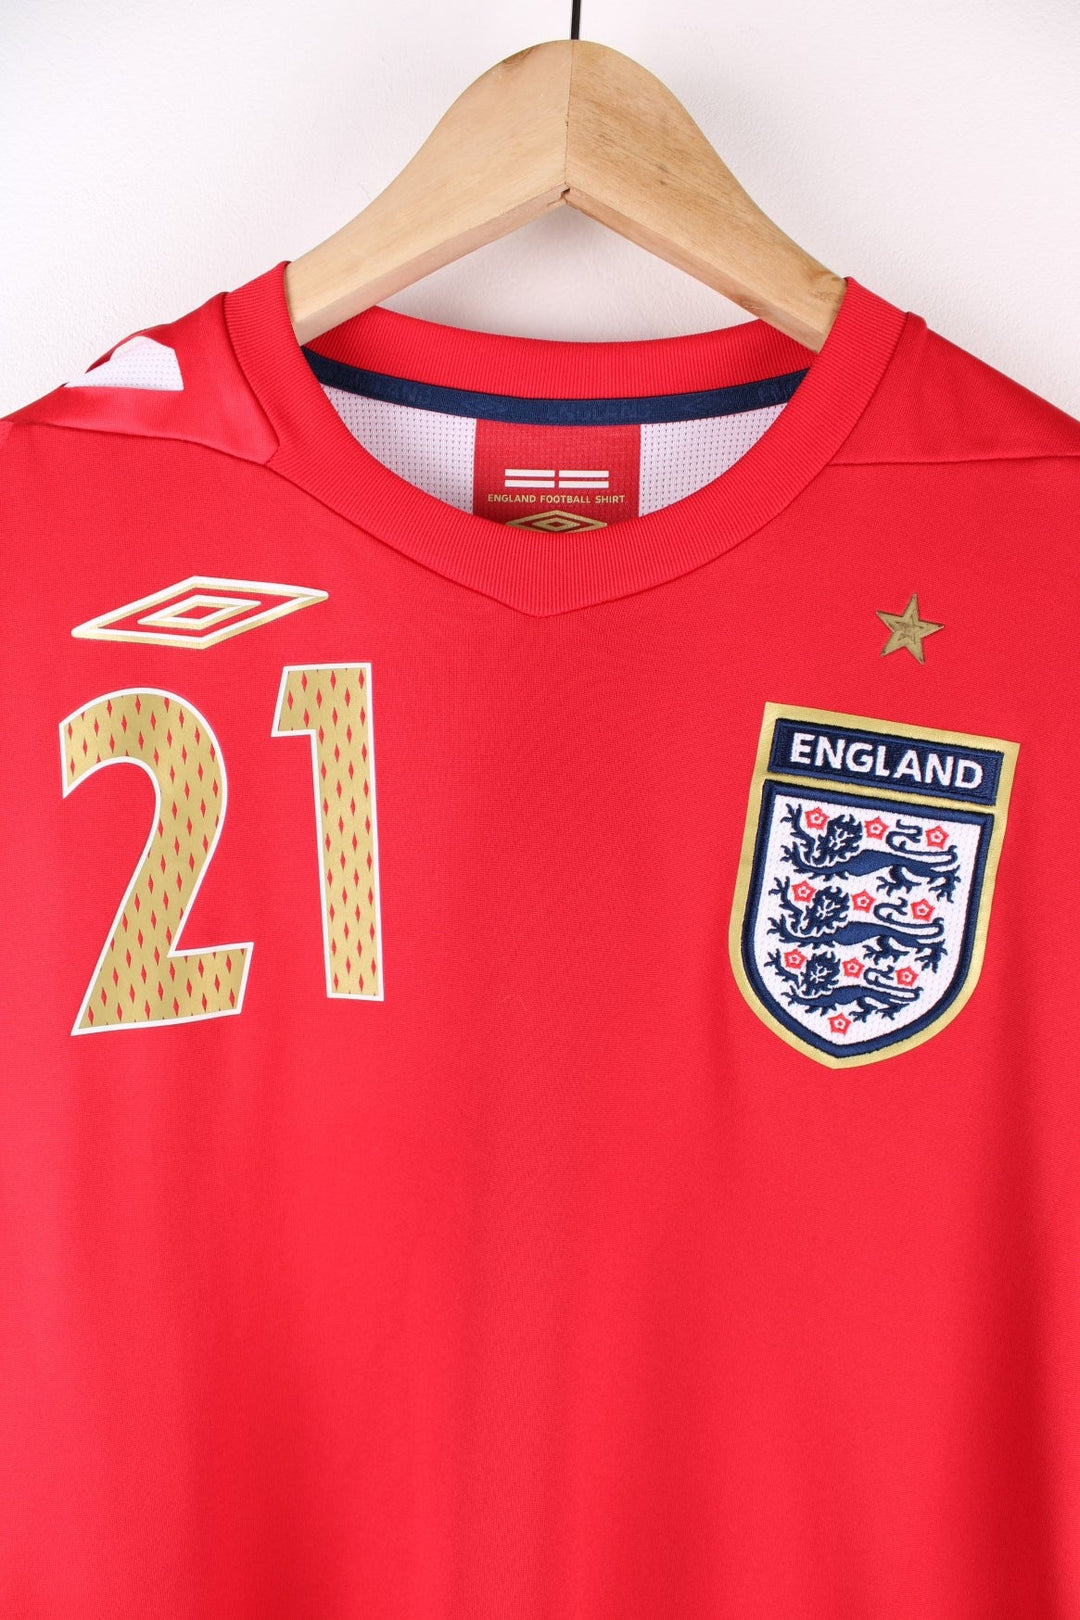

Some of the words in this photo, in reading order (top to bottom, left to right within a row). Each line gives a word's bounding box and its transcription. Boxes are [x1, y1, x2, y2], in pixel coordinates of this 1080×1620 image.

[487, 493, 537, 503] ENGLAND
[539, 494, 591, 504] FOOTBALL
[595, 494, 626, 504] SHIRT
[790, 732, 983, 789] ENGLAND
[59, 662, 384, 1036] 21
